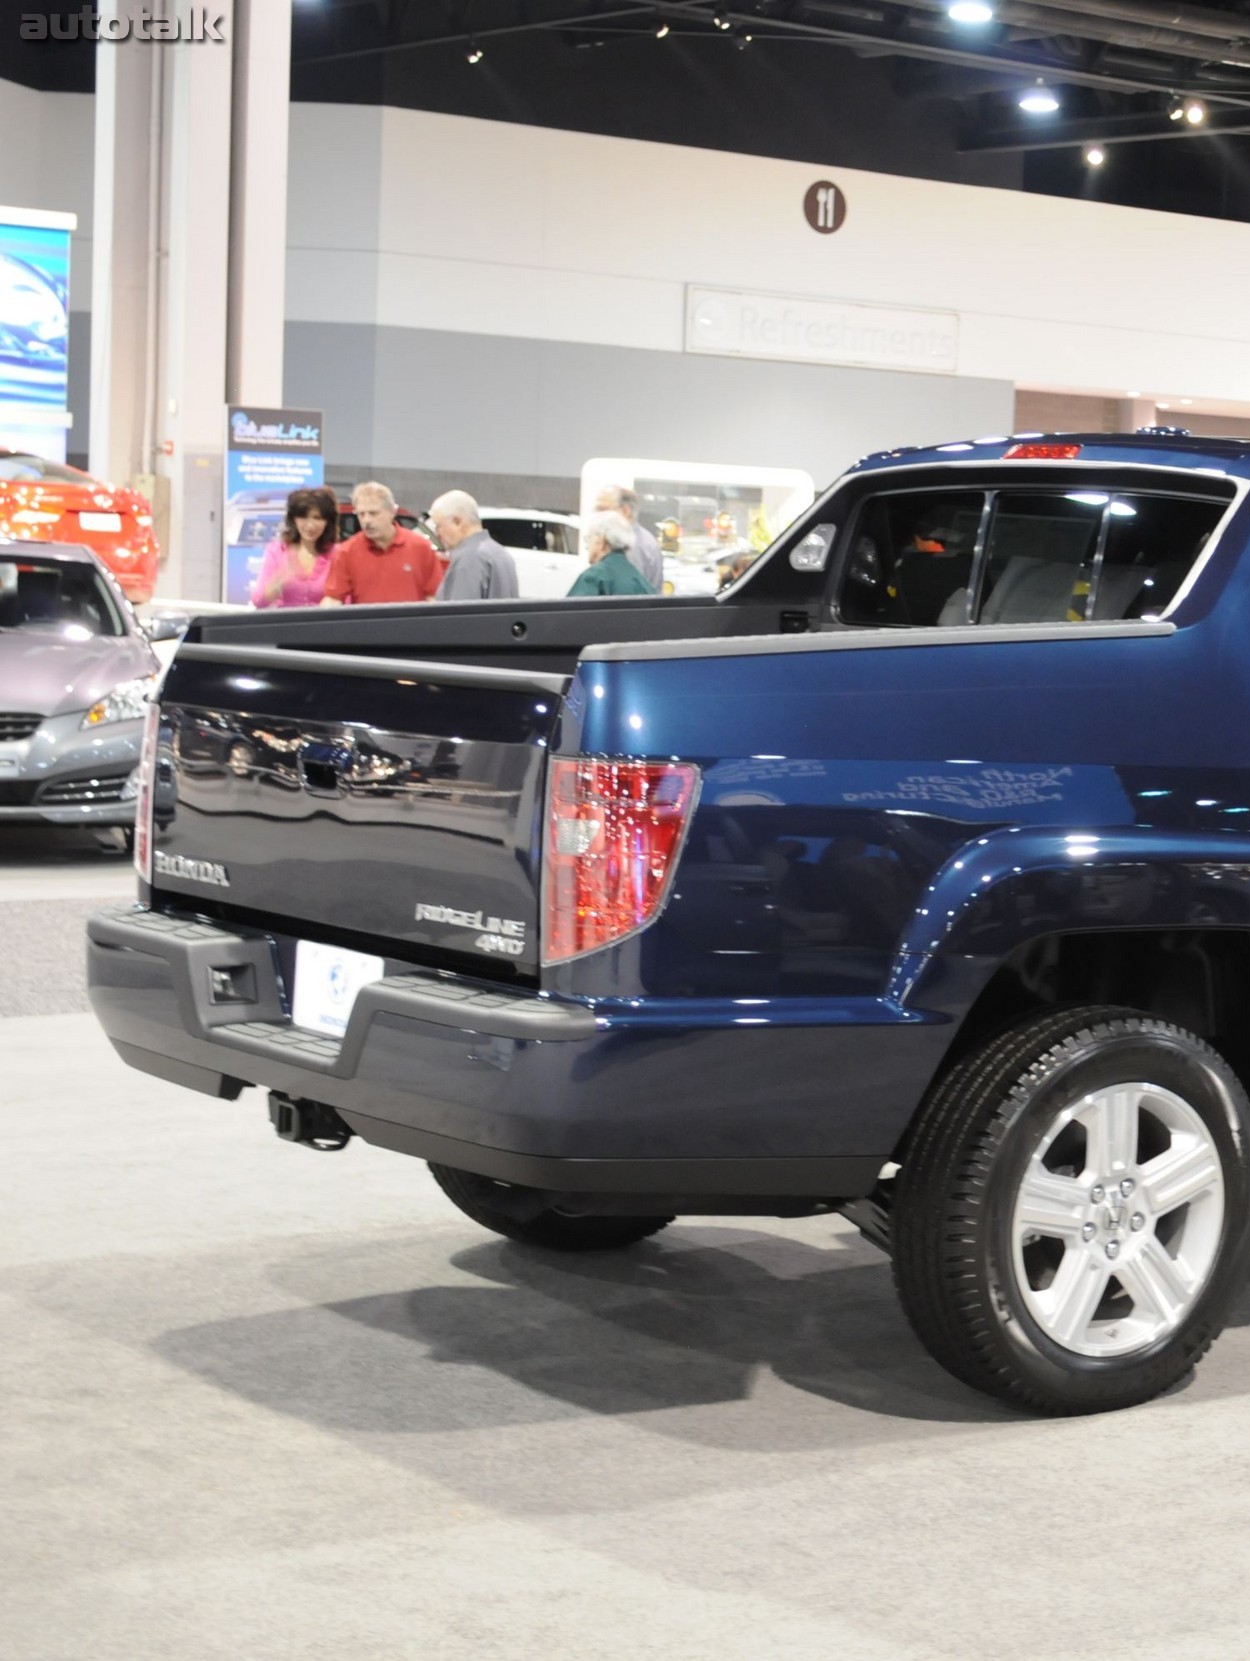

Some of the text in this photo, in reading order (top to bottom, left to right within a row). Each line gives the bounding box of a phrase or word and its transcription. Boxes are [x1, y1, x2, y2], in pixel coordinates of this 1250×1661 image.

[738, 304, 956, 358] Refreshments
[154, 850, 231, 888] HONDA
[414, 902, 526, 937] RIDGELINE
[475, 934, 526, 955] 4WD
